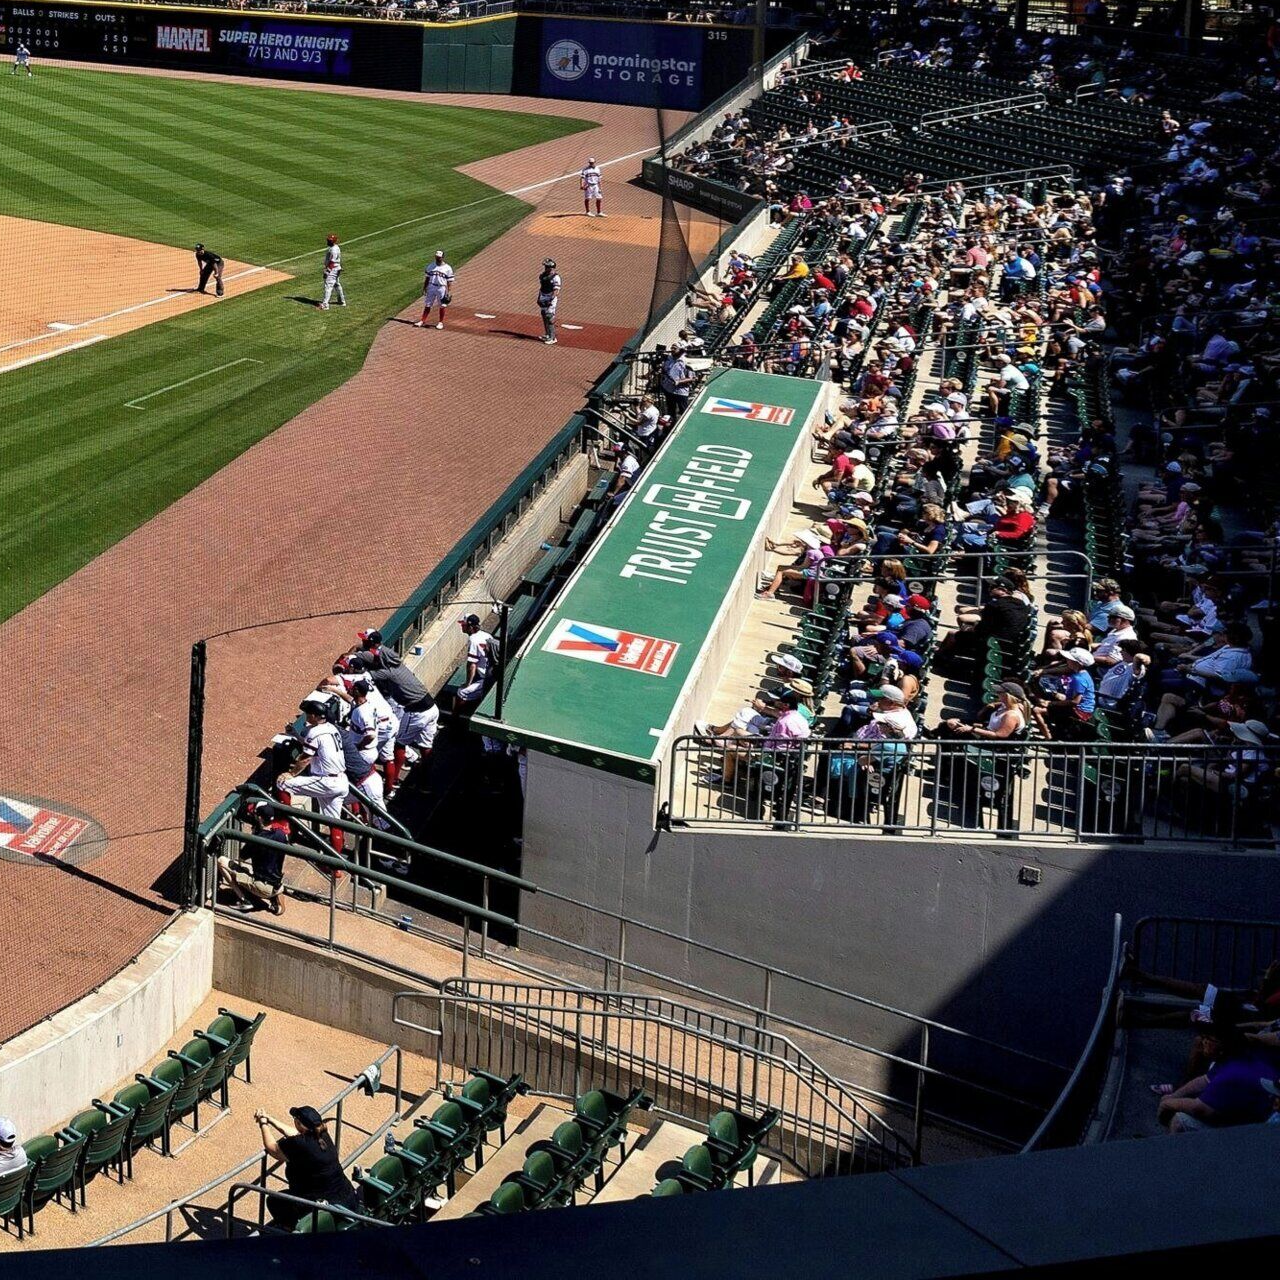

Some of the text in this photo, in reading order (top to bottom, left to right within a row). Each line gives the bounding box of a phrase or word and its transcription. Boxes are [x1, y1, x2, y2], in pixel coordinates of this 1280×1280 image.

[12, 8, 35, 17] BALLS
[48, 10, 79, 20] STRIKES
[95, 14, 116, 22] OUTS
[157, 25, 211, 52] MARVEL
[218, 29, 349, 51] SUPER HERO KNIGHTS
[707, 31, 728, 41] 315
[247, 44, 321, 63] 7/13 AND 9/3
[593, 54, 696, 72] morningstar
[593, 68, 695, 86] STORAGE
[668, 175, 694, 191] SHARP
[677, 444, 754, 492] FIELD
[620, 511, 718, 585] TRUIST
